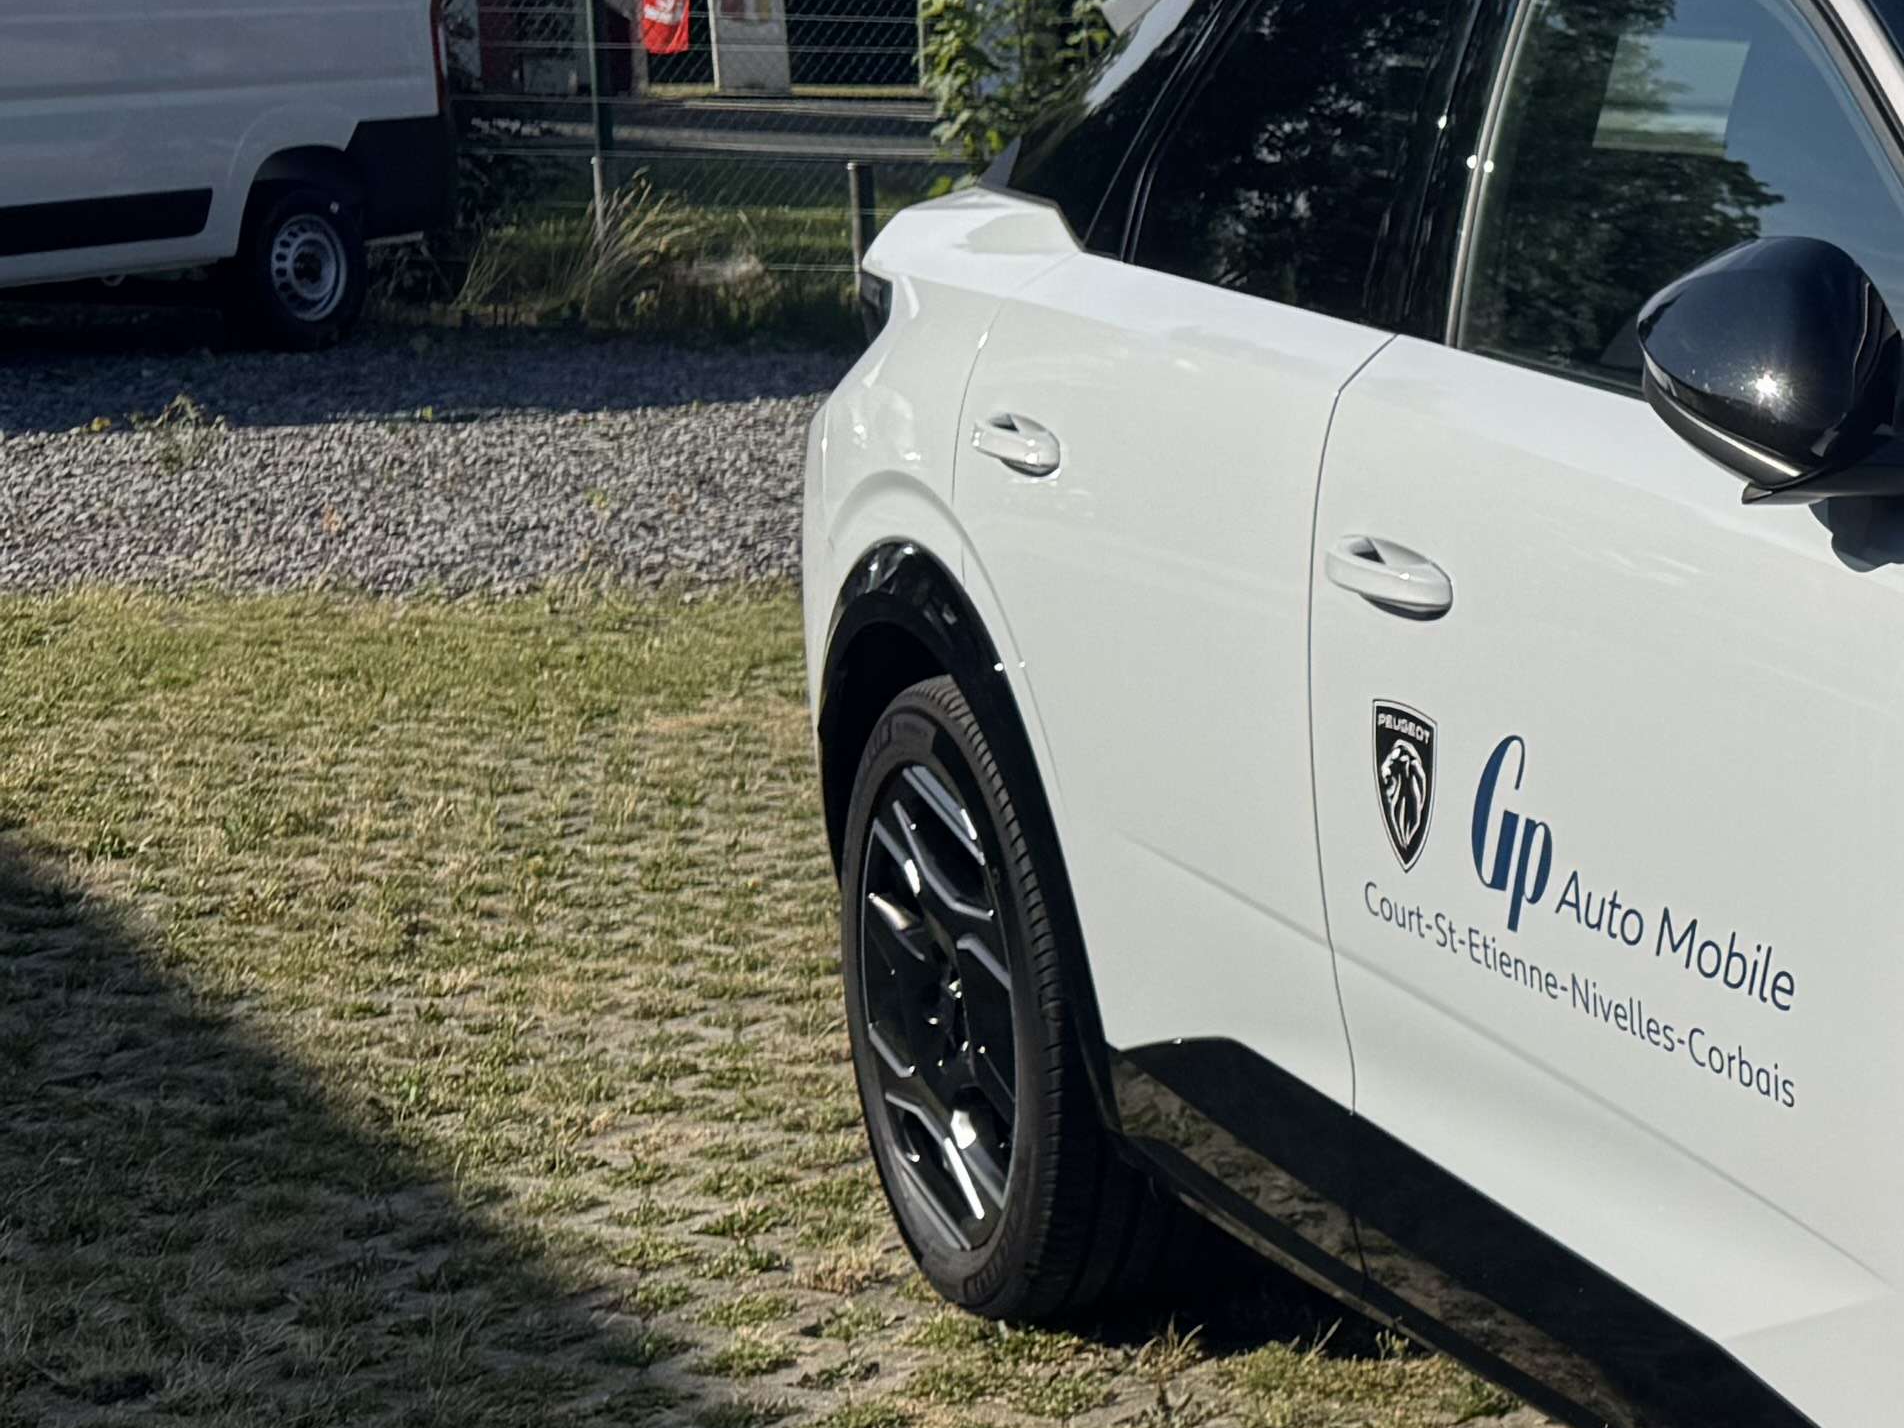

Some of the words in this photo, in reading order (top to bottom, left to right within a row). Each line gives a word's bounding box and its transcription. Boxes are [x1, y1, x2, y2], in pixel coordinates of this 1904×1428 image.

[1377, 713, 1431, 745] PEUGEOT
[1470, 734, 1554, 933] Gp
[1554, 870, 1645, 947] Auto
[1655, 905, 1796, 1012] Mobile
